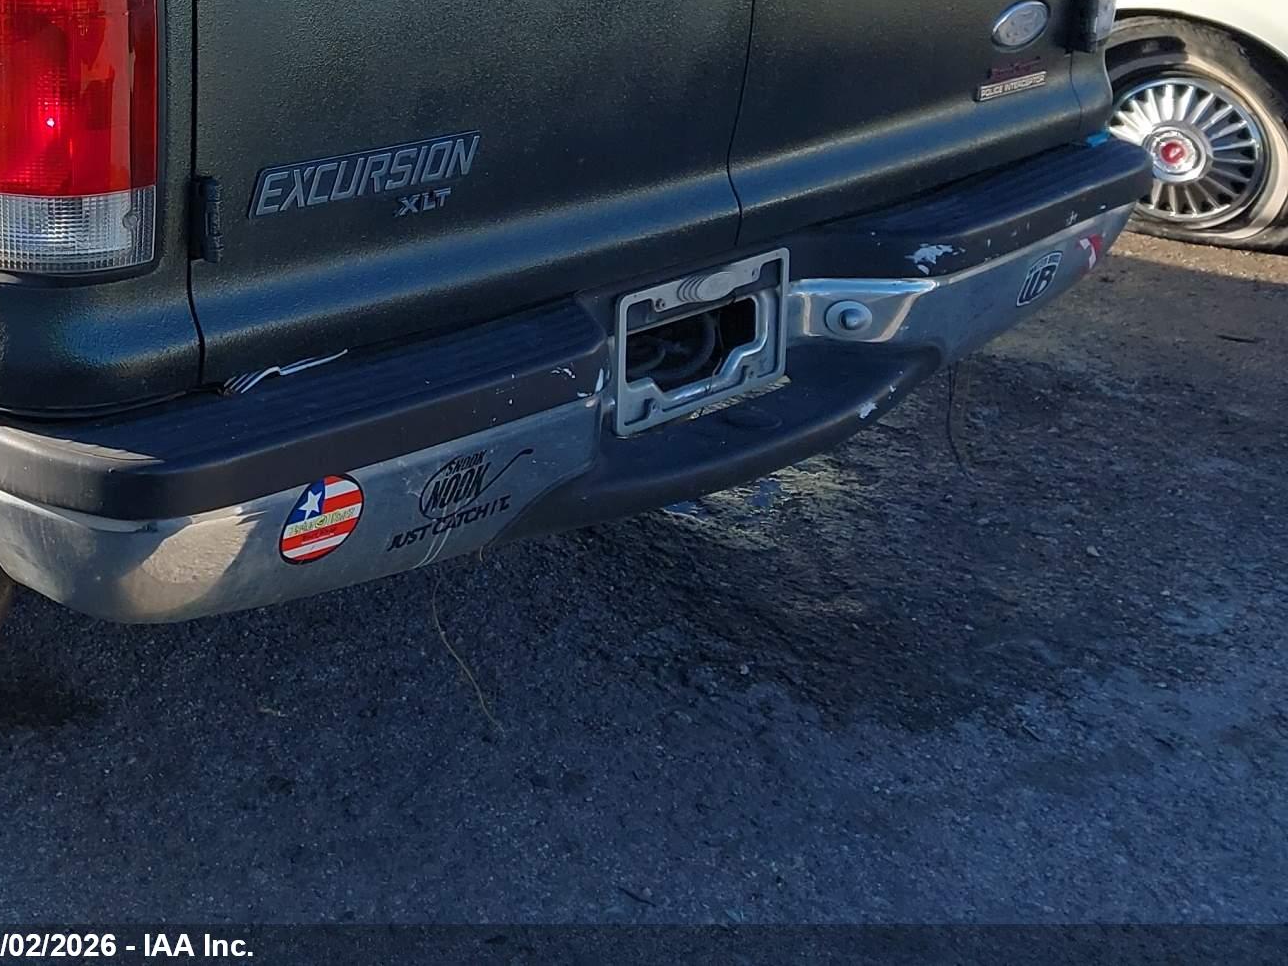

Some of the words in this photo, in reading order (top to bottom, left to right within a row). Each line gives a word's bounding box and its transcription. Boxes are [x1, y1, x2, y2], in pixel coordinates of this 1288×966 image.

[980, 83, 1003, 98] POLICE
[255, 135, 481, 217] EXCURSION
[397, 187, 452, 216] XLT
[424, 461, 493, 515] NOOK
[387, 523, 433, 552] JUST
